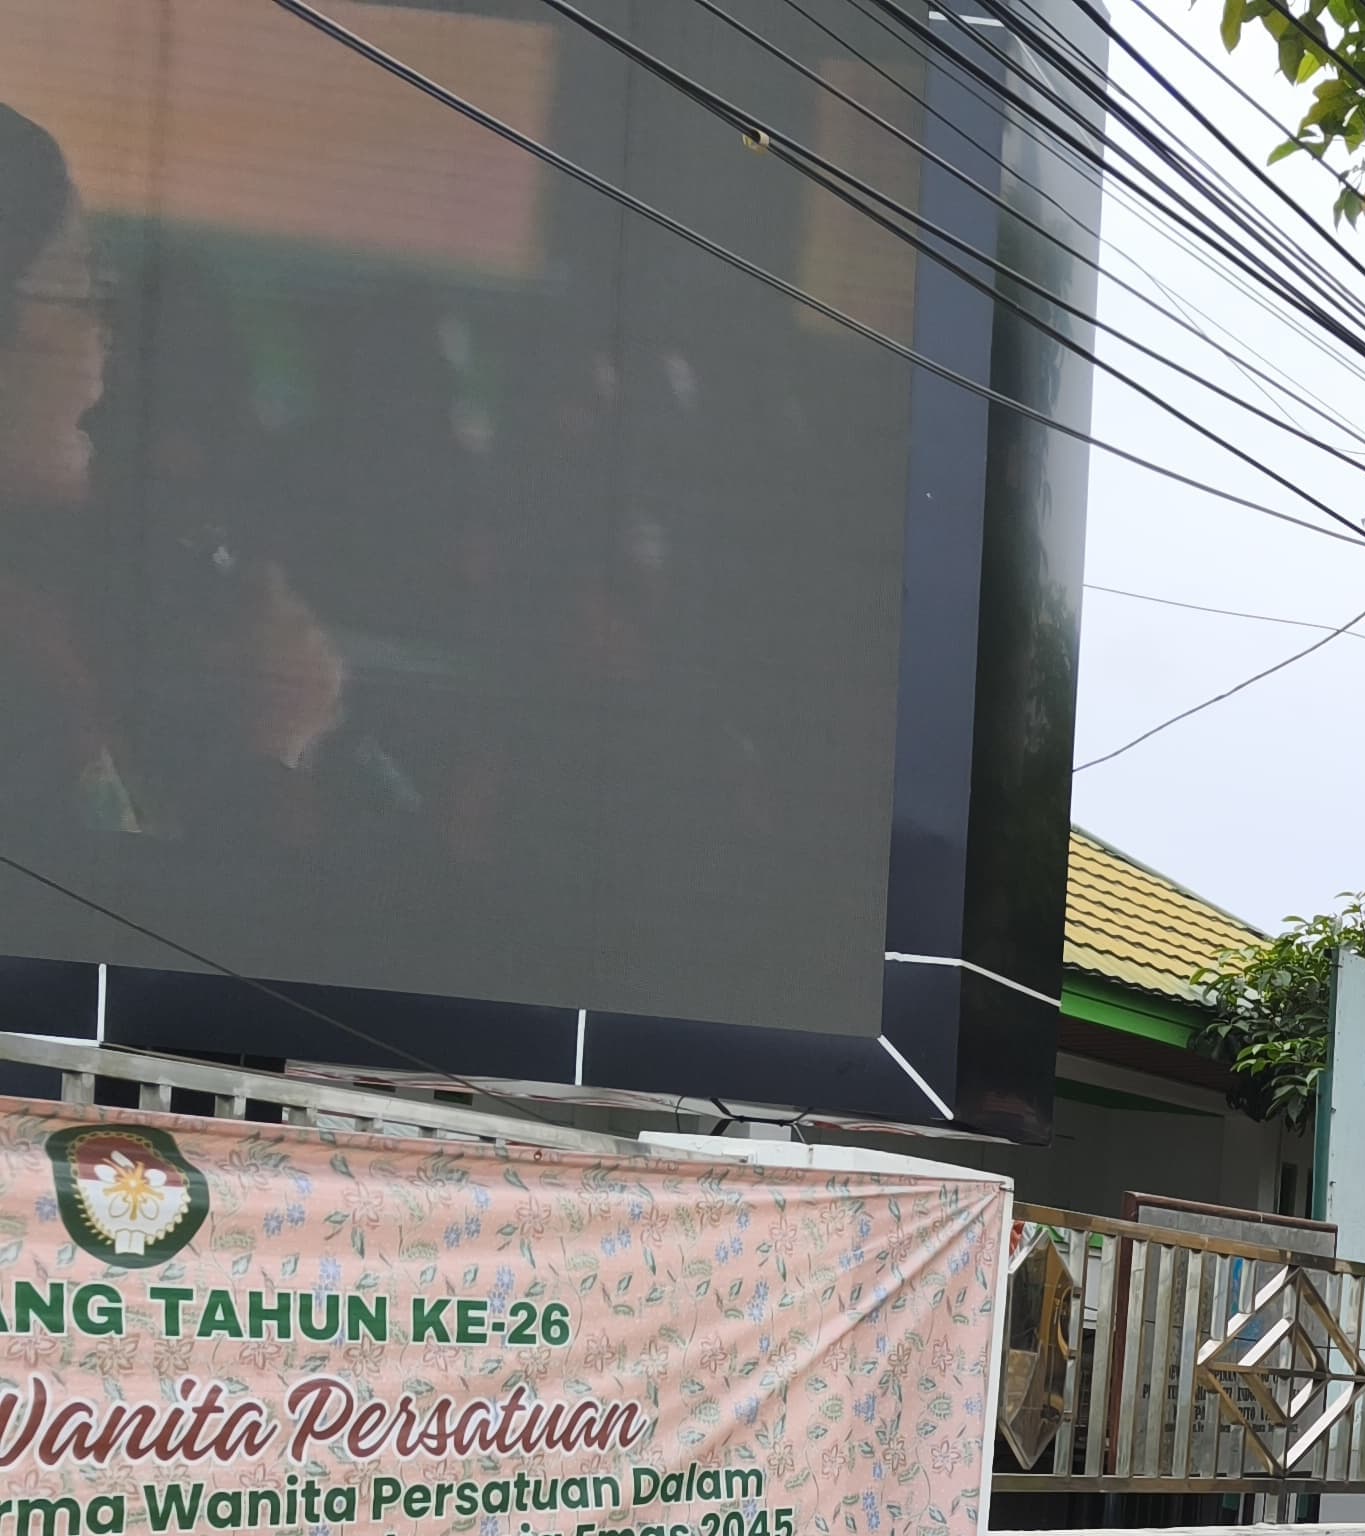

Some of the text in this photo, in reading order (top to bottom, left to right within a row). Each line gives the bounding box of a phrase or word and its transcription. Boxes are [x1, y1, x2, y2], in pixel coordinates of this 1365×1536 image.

[0, 1280, 571, 1346] NG TAHUN KE-26
[287, 1377, 648, 1463] Persatuan
[143, 1474, 357, 1532] Wanita
[371, 1471, 620, 1521] Persatuan
[632, 1463, 763, 1506] Dalam
